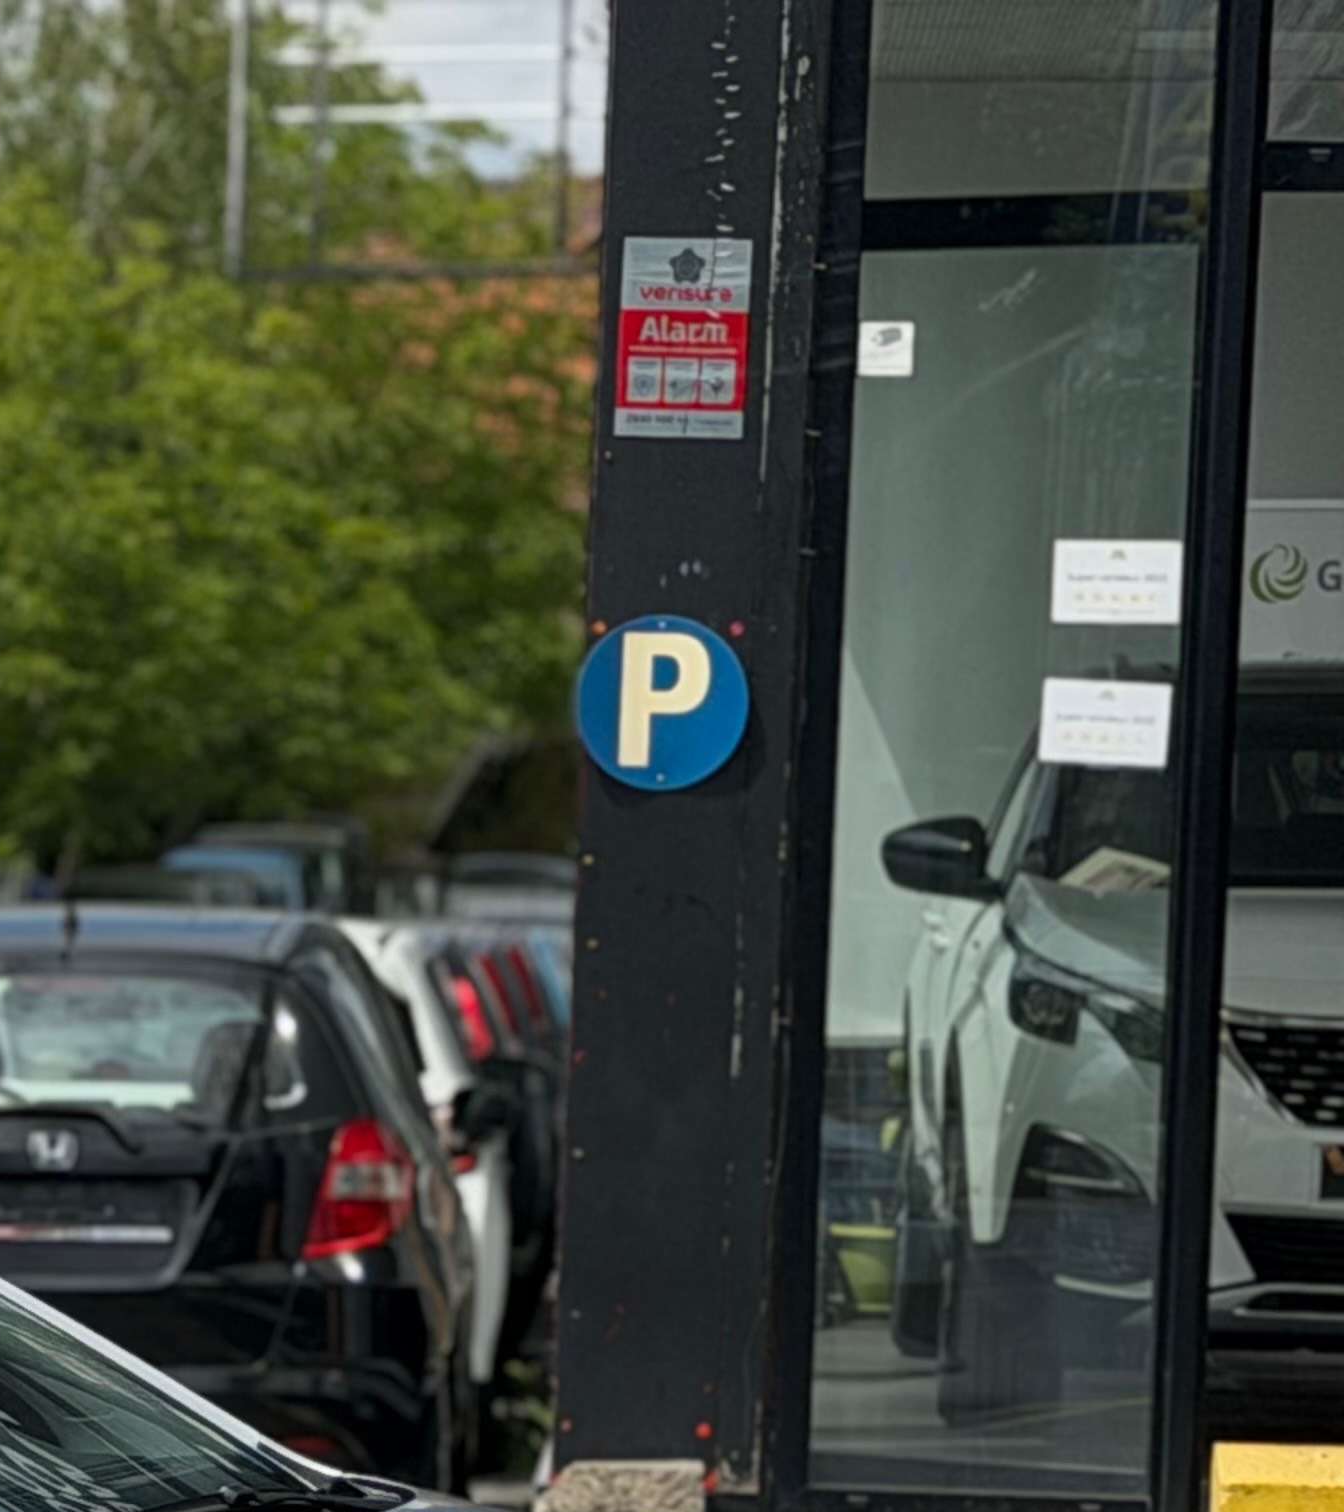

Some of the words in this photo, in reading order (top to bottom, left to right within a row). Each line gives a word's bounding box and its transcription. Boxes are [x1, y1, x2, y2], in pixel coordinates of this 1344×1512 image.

[640, 284, 733, 303] verisure
[639, 314, 728, 344] Alarm
[618, 631, 712, 768] P
